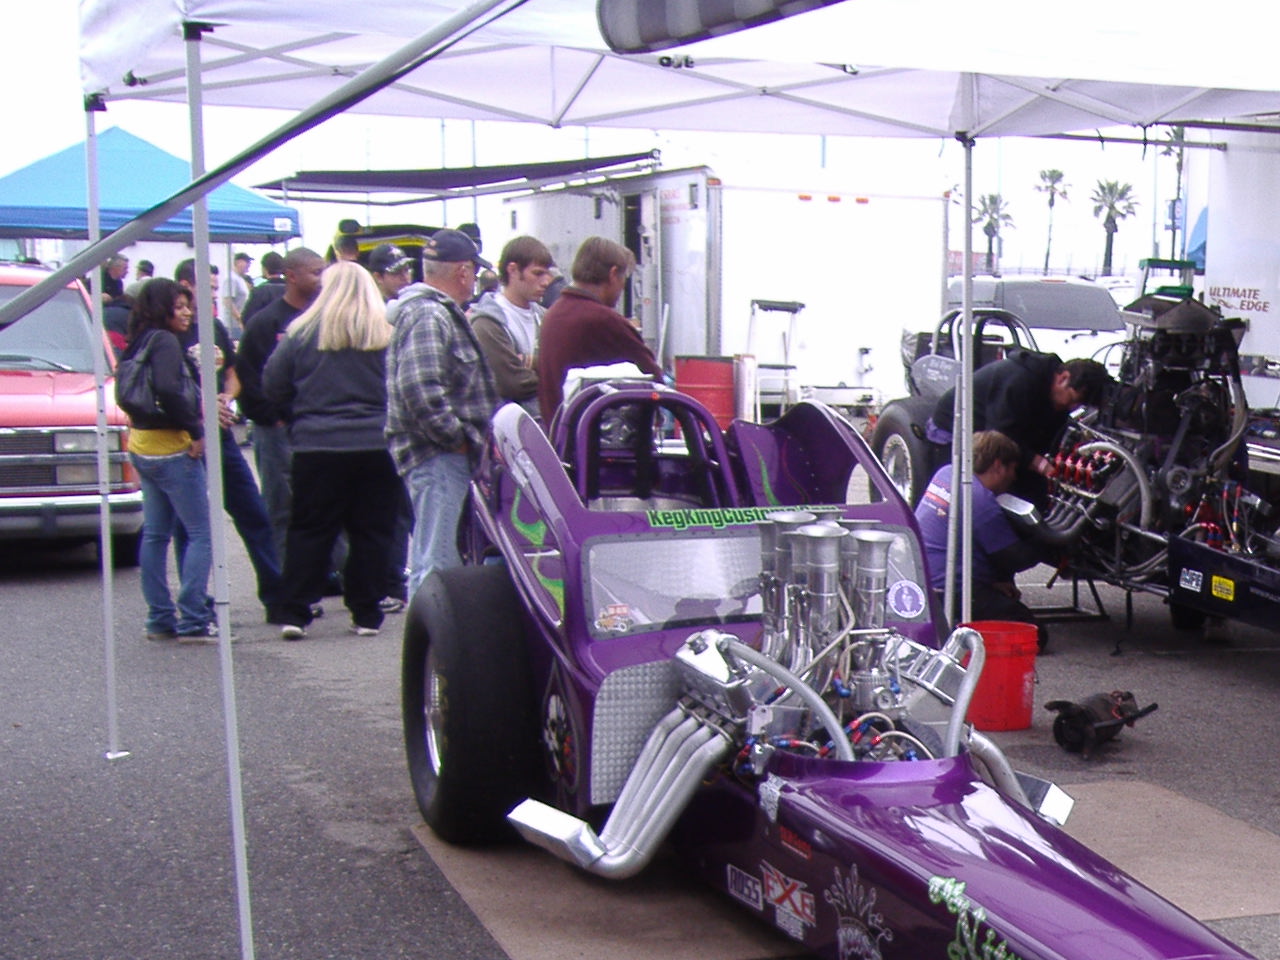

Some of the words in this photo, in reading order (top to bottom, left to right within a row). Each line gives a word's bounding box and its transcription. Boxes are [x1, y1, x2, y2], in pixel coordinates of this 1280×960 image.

[1209, 286, 1260, 299] ULTIMATE
[1240, 300, 1270, 312] EDGE
[730, 867, 761, 907] ROSS
